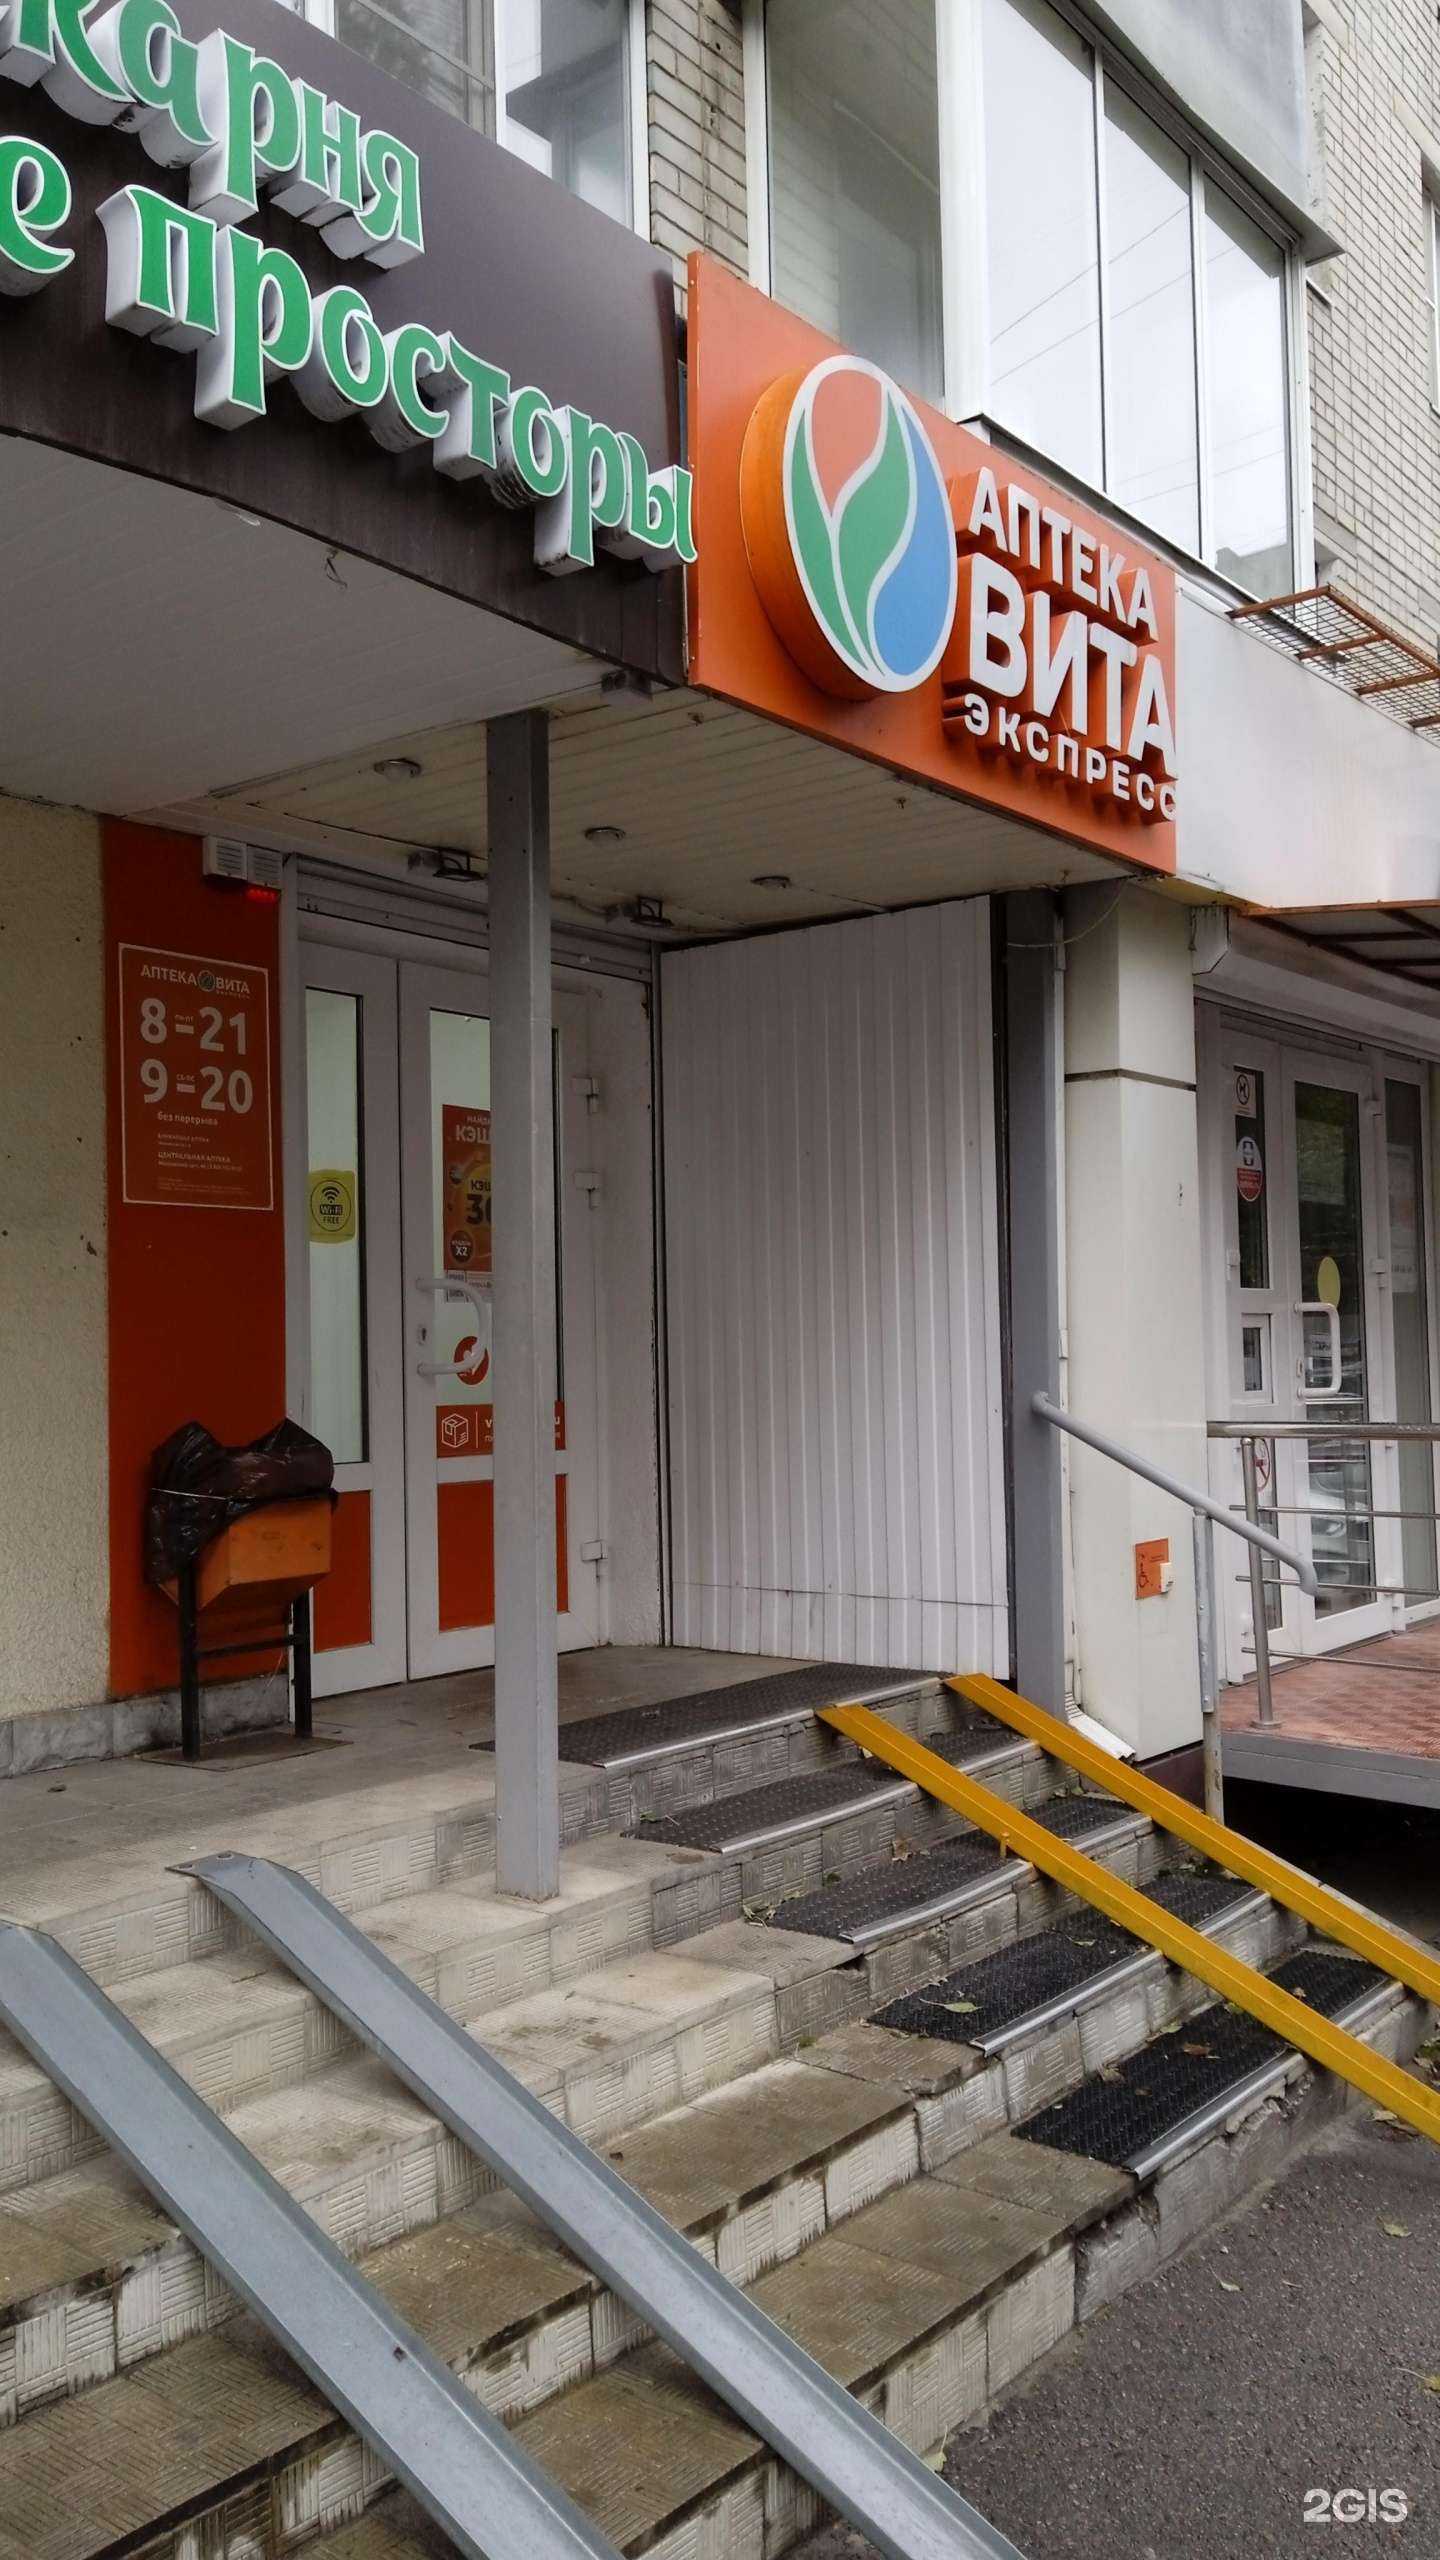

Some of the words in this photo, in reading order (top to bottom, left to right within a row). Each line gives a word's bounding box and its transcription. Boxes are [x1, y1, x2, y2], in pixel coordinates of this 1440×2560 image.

[122, 184, 699, 567] просторы
[968, 466, 1160, 643] АПТЕКА
[970, 553, 1178, 781] ВИТА
[964, 693, 1177, 822] ЭКСПРЕСС
[140, 964, 198, 986] АПТЕКА
[215, 977, 250, 993] ВИТА
[157, 1111, 173, 1122] без
[323, 1216, 340, 1225] FREE
